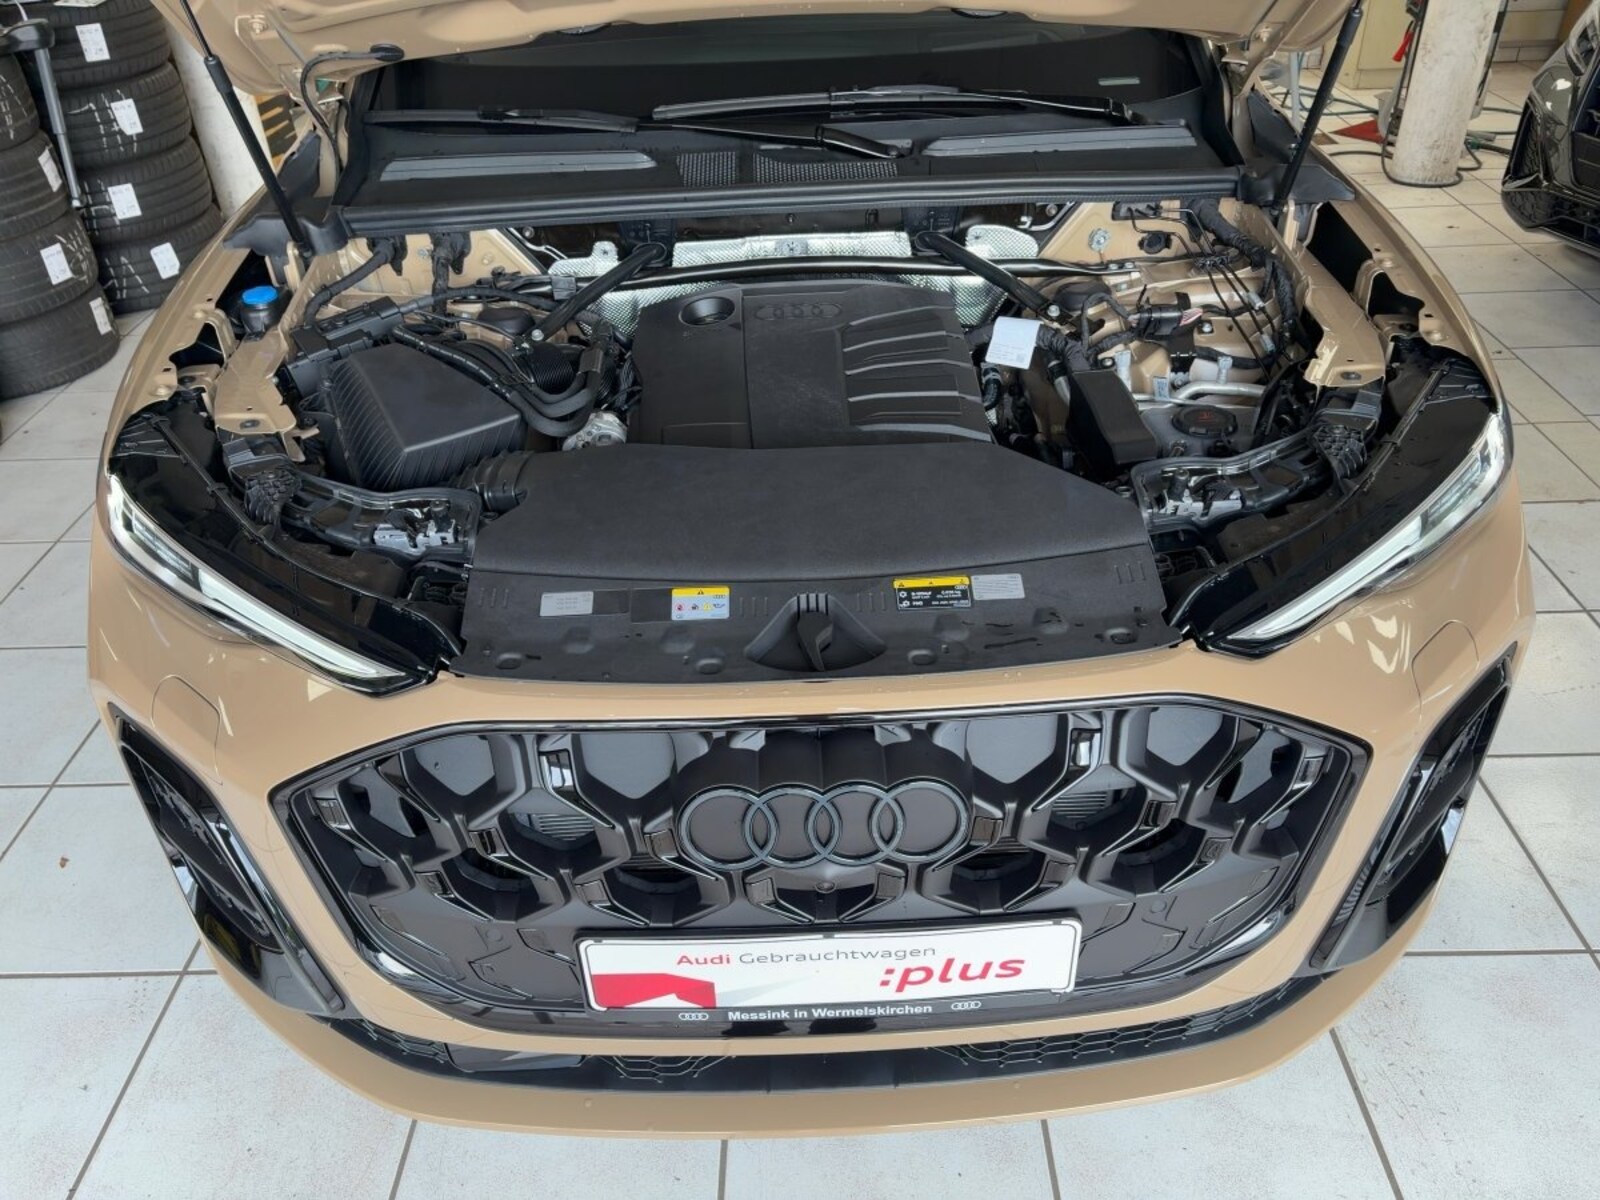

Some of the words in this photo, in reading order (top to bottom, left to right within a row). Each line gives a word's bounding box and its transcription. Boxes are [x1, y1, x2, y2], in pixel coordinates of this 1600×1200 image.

[677, 954, 731, 965] Audi
[739, 948, 936, 965] Gebrauchtwagen
[727, 1010, 791, 1021] Messink
[794, 1008, 808, 1018] in
[811, 1003, 933, 1018] Wermelskirchen
